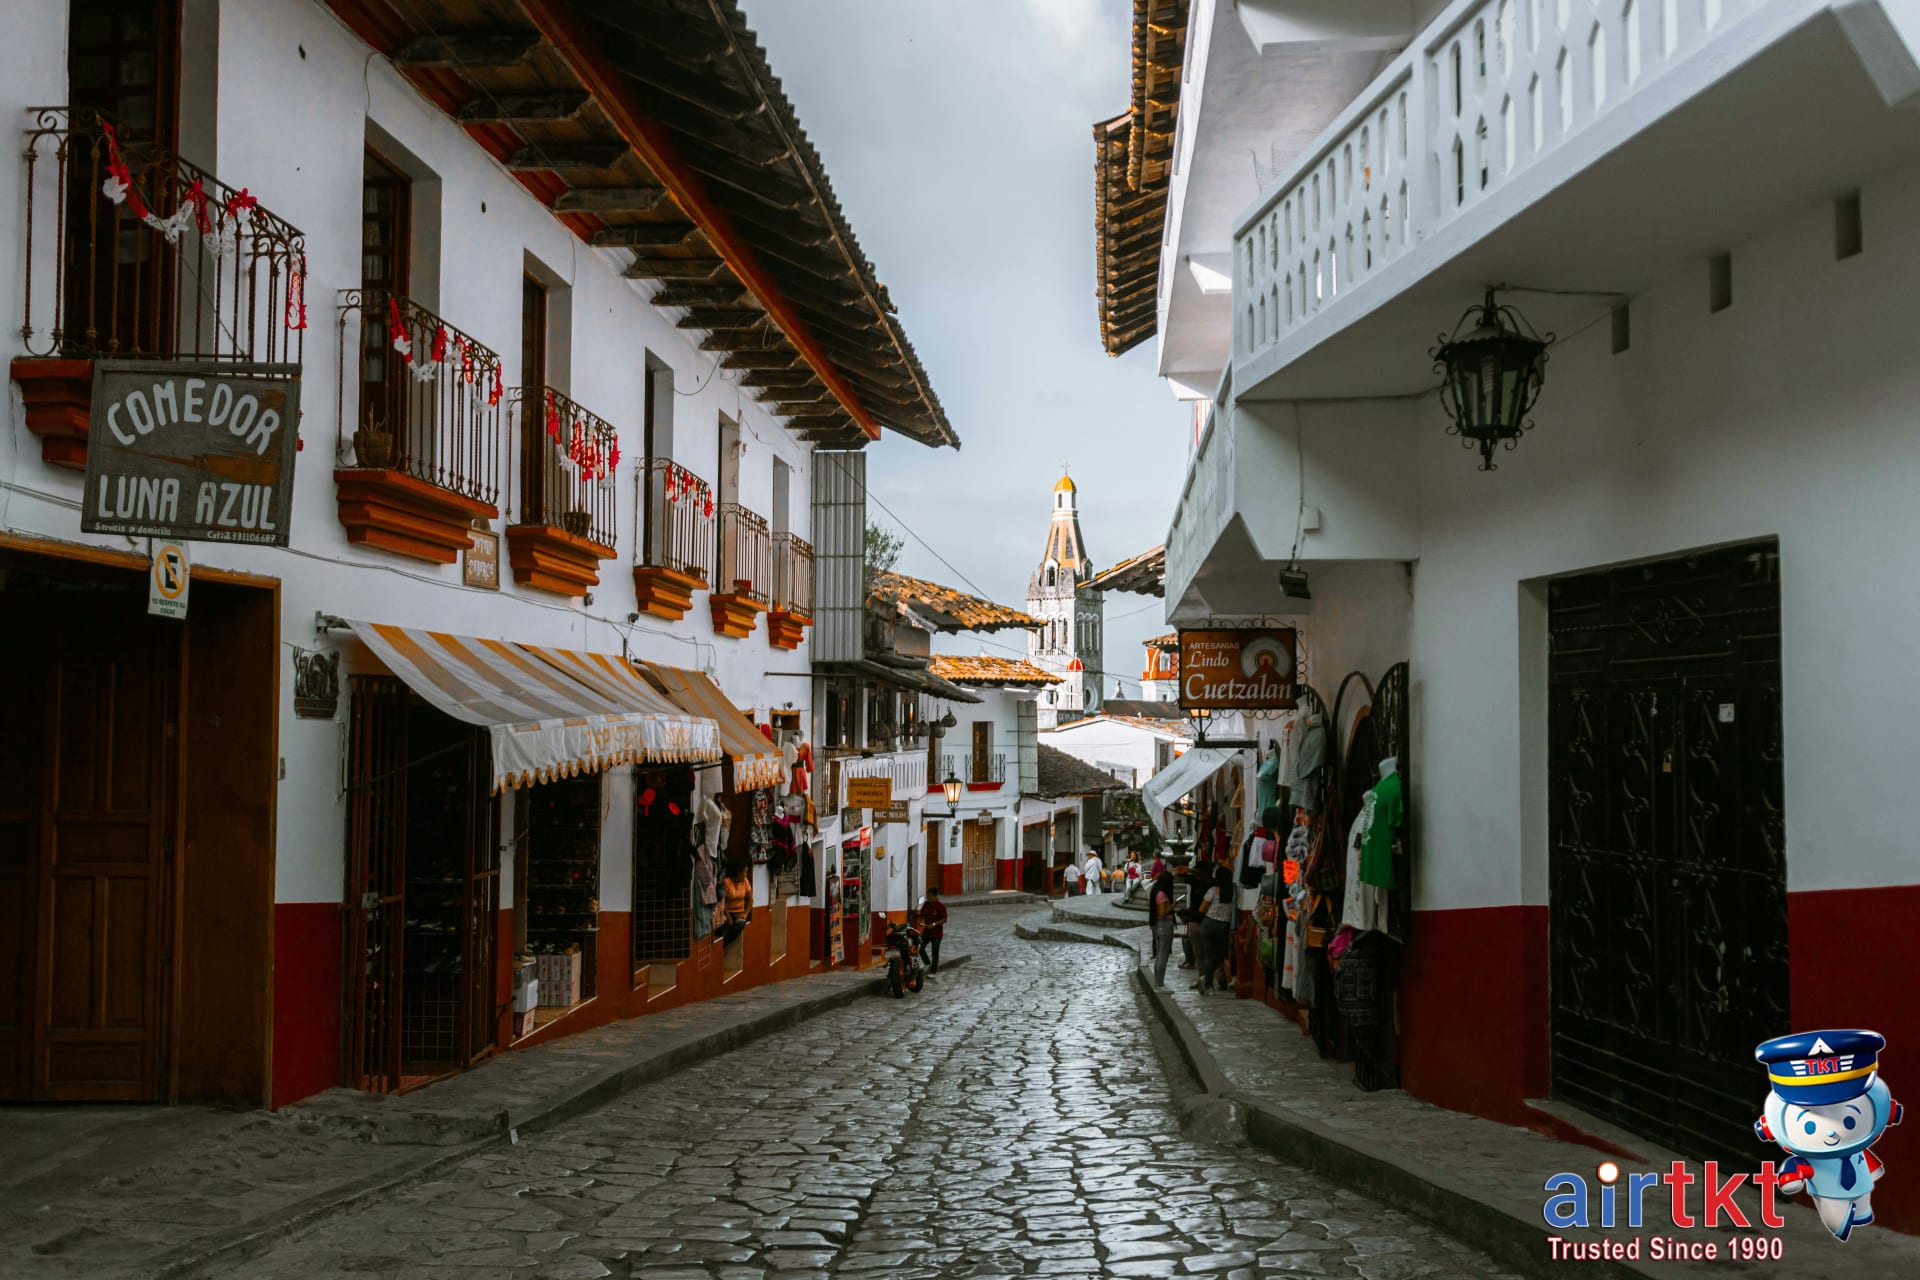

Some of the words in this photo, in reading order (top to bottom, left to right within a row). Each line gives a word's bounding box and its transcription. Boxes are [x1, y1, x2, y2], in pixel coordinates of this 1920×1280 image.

[107, 378, 280, 456] COMEDOR
[98, 475, 180, 522] LUNA
[195, 481, 276, 530] AZUL
[1186, 650, 1230, 669] Lindo
[1185, 673, 1293, 700] Cuetzalan
